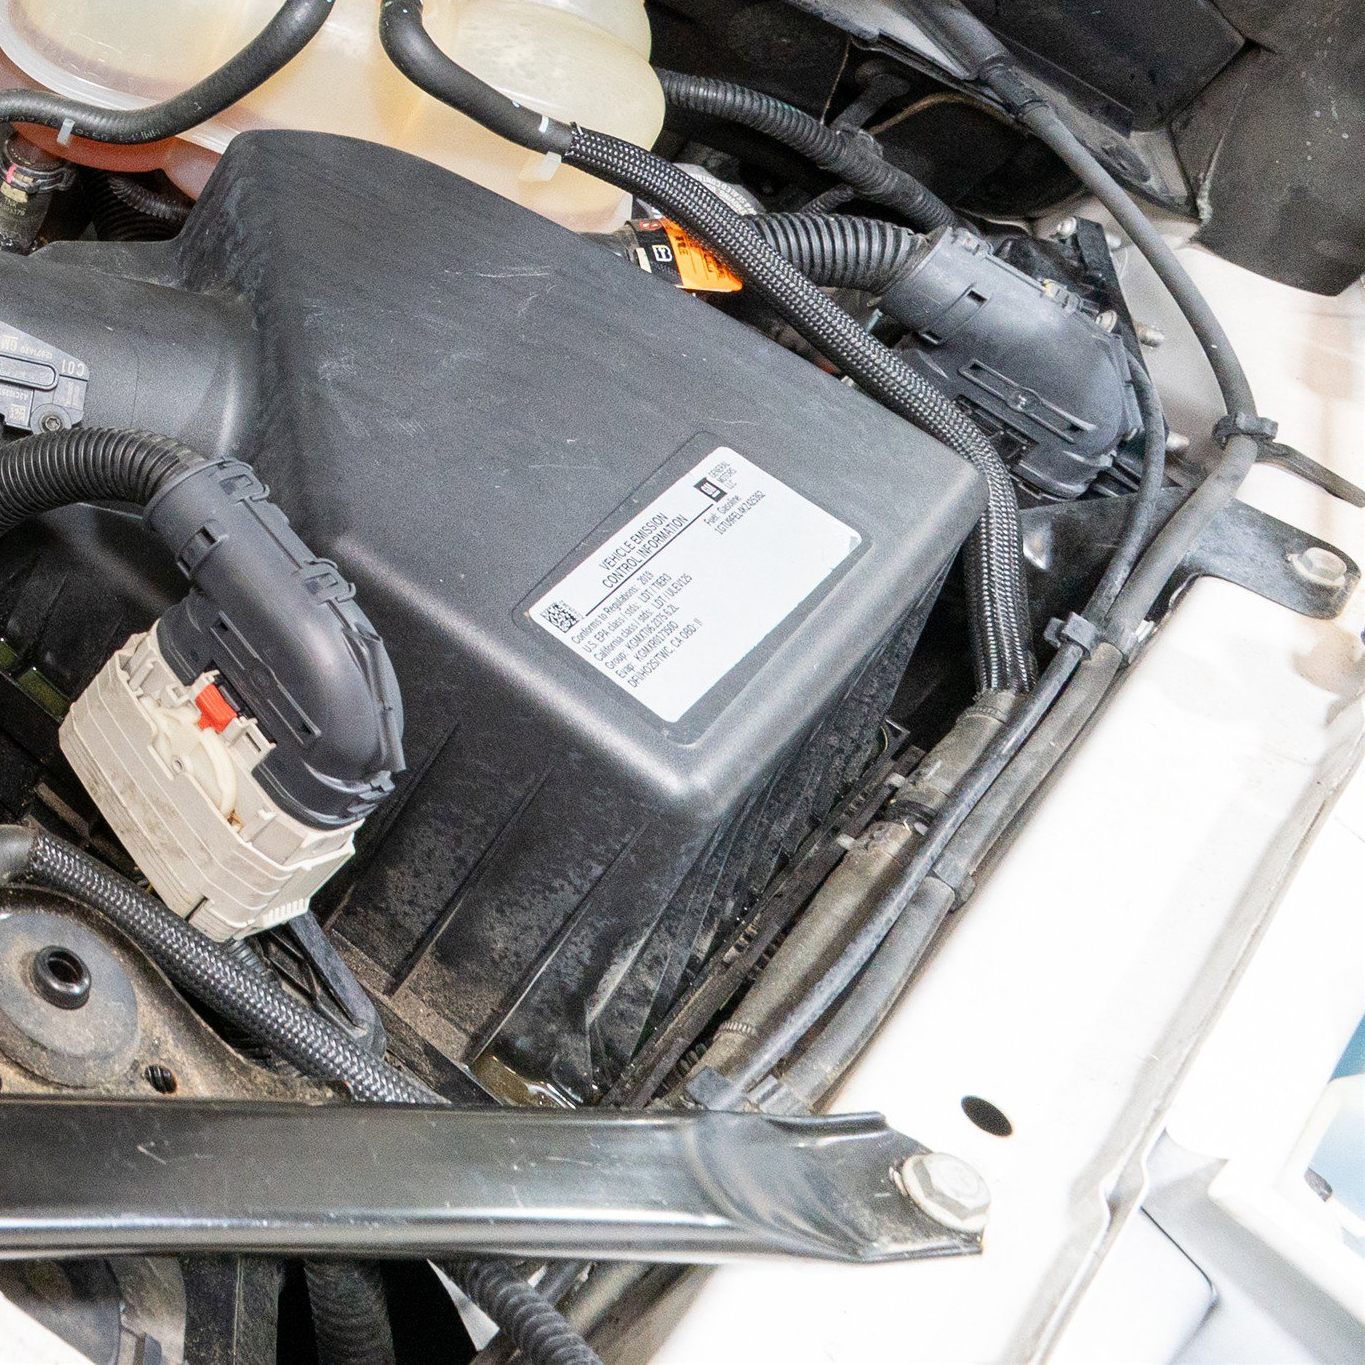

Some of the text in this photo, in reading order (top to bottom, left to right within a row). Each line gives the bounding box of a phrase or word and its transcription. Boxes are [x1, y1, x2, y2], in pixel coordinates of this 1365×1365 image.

[708, 462, 730, 478] GENERAL
[716, 495, 741, 514] Gasoline
[599, 513, 668, 571] VEHICLE EMISSION
[602, 514, 688, 588] CONTROL INFORMATION
[571, 618, 602, 644] Conforms
[597, 613, 608, 621] to
[603, 583, 641, 616] Regulations:
[637, 571, 654, 585] 2019
[594, 629, 609, 643] EPA
[607, 617, 625, 632] class
[624, 604, 641, 617] stds:
[638, 589, 653, 603] LDT
[651, 573, 672, 589] TIER3
[593, 636, 624, 661] California
[620, 623, 638, 638] class
[637, 610, 653, 623] stds:
[651, 595, 667, 610] LDT
[670, 637, 683, 648] CA
[604, 652, 627, 670] Group:
[615, 663, 635, 679] Evap:
